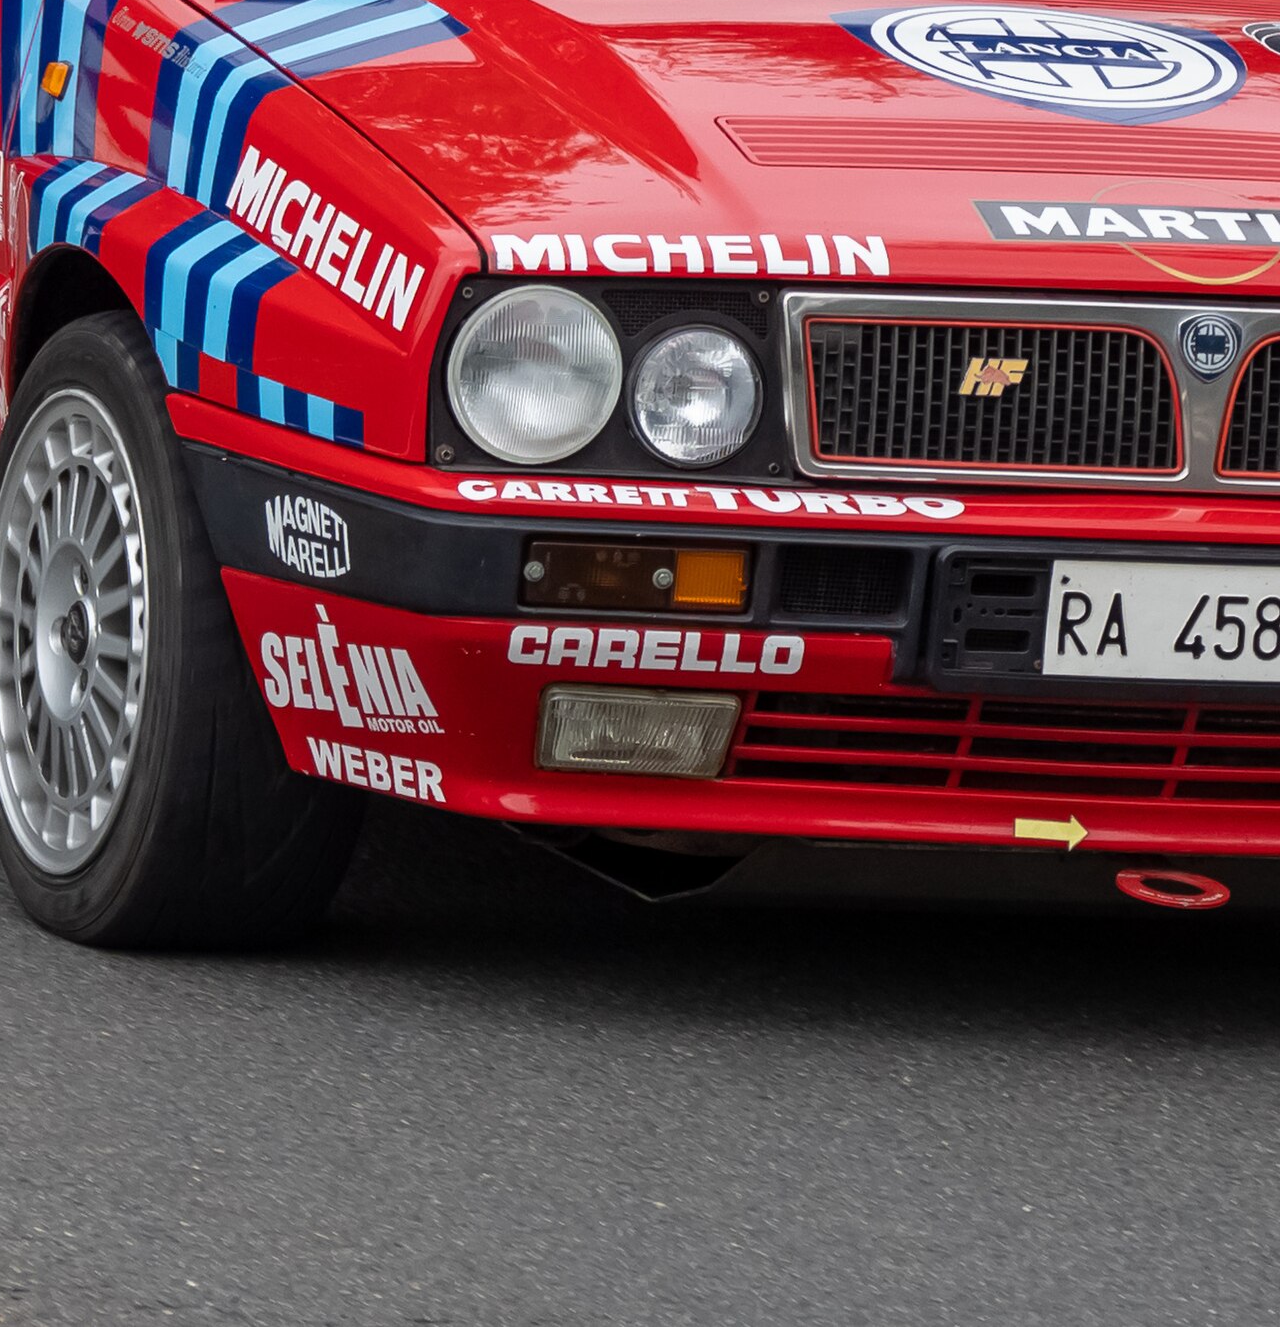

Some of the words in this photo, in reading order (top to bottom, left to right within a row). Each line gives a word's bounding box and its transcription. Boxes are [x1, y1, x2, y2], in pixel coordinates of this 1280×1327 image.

[954, 39, 1158, 62] LANCIA
[226, 145, 425, 332] MICHELIN
[490, 233, 891, 276] MICHELIN
[959, 357, 1029, 396] HF
[265, 494, 350, 542] MAGNETI
[457, 479, 692, 508] GARRETT
[694, 487, 966, 519] TURBO
[265, 527, 351, 577] MARELLI
[1058, 591, 1128, 658] RA
[508, 625, 805, 675] CARELLO
[367, 717, 417, 734] MOTOR
[419, 718, 445, 734] OIL
[307, 736, 447, 803] WEBER
